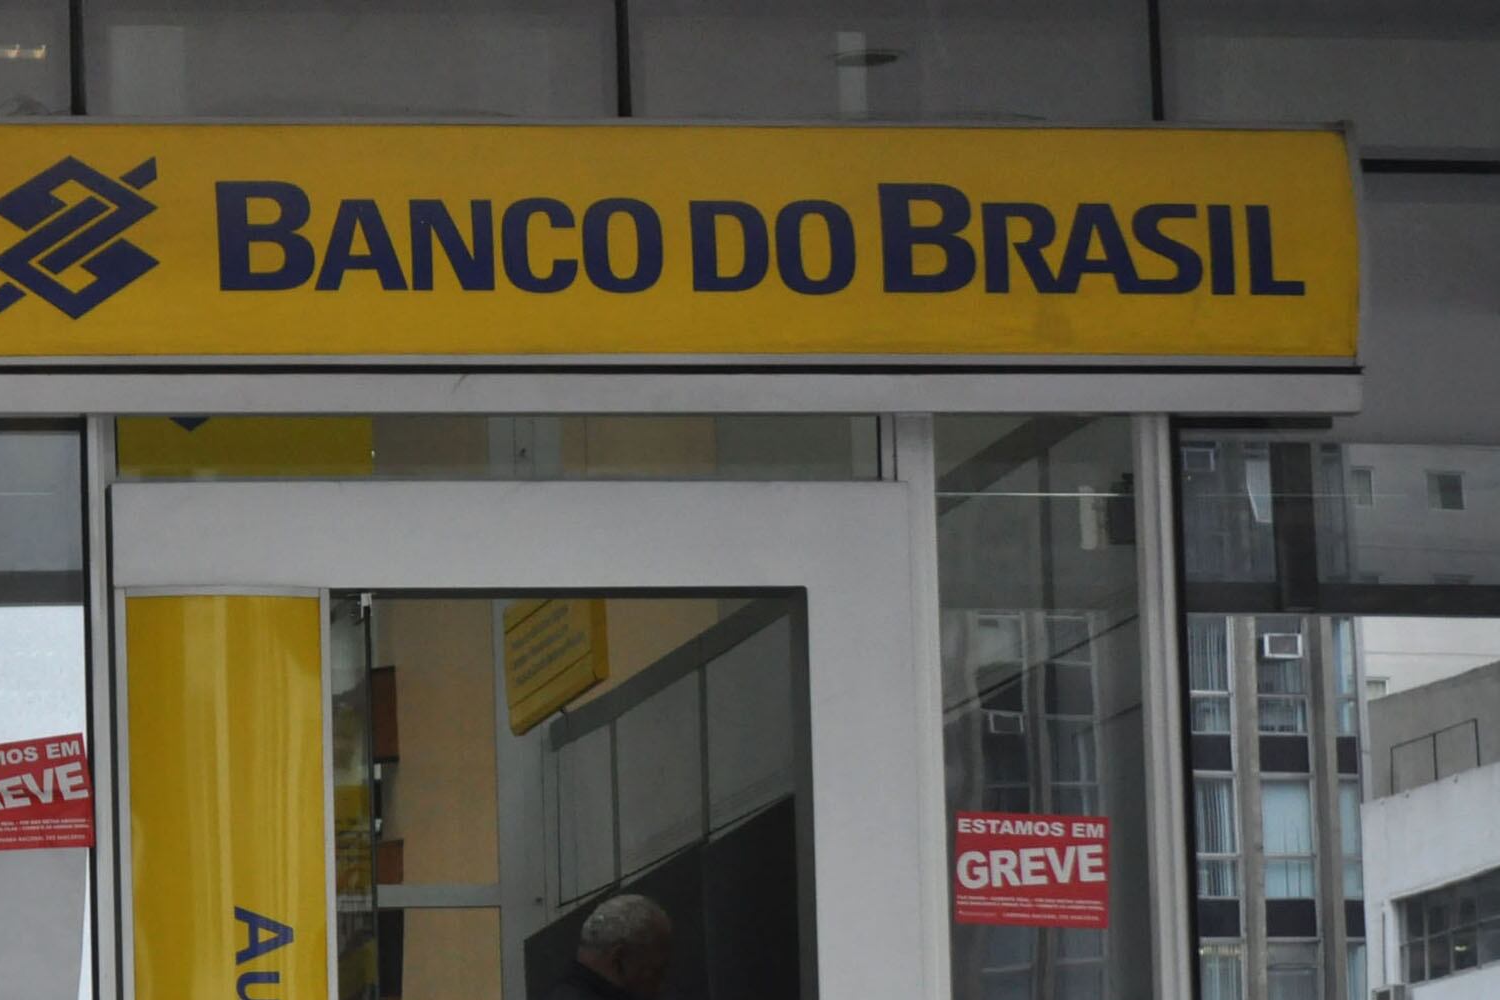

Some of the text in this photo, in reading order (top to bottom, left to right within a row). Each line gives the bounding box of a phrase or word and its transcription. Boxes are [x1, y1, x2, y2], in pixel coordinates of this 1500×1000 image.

[214, 181, 1305, 296] BANCO DO BRASIL
[46, 740, 80, 759] EM
[957, 818, 1104, 838] ESTAMOS EM
[957, 844, 1105, 889] GREVE
